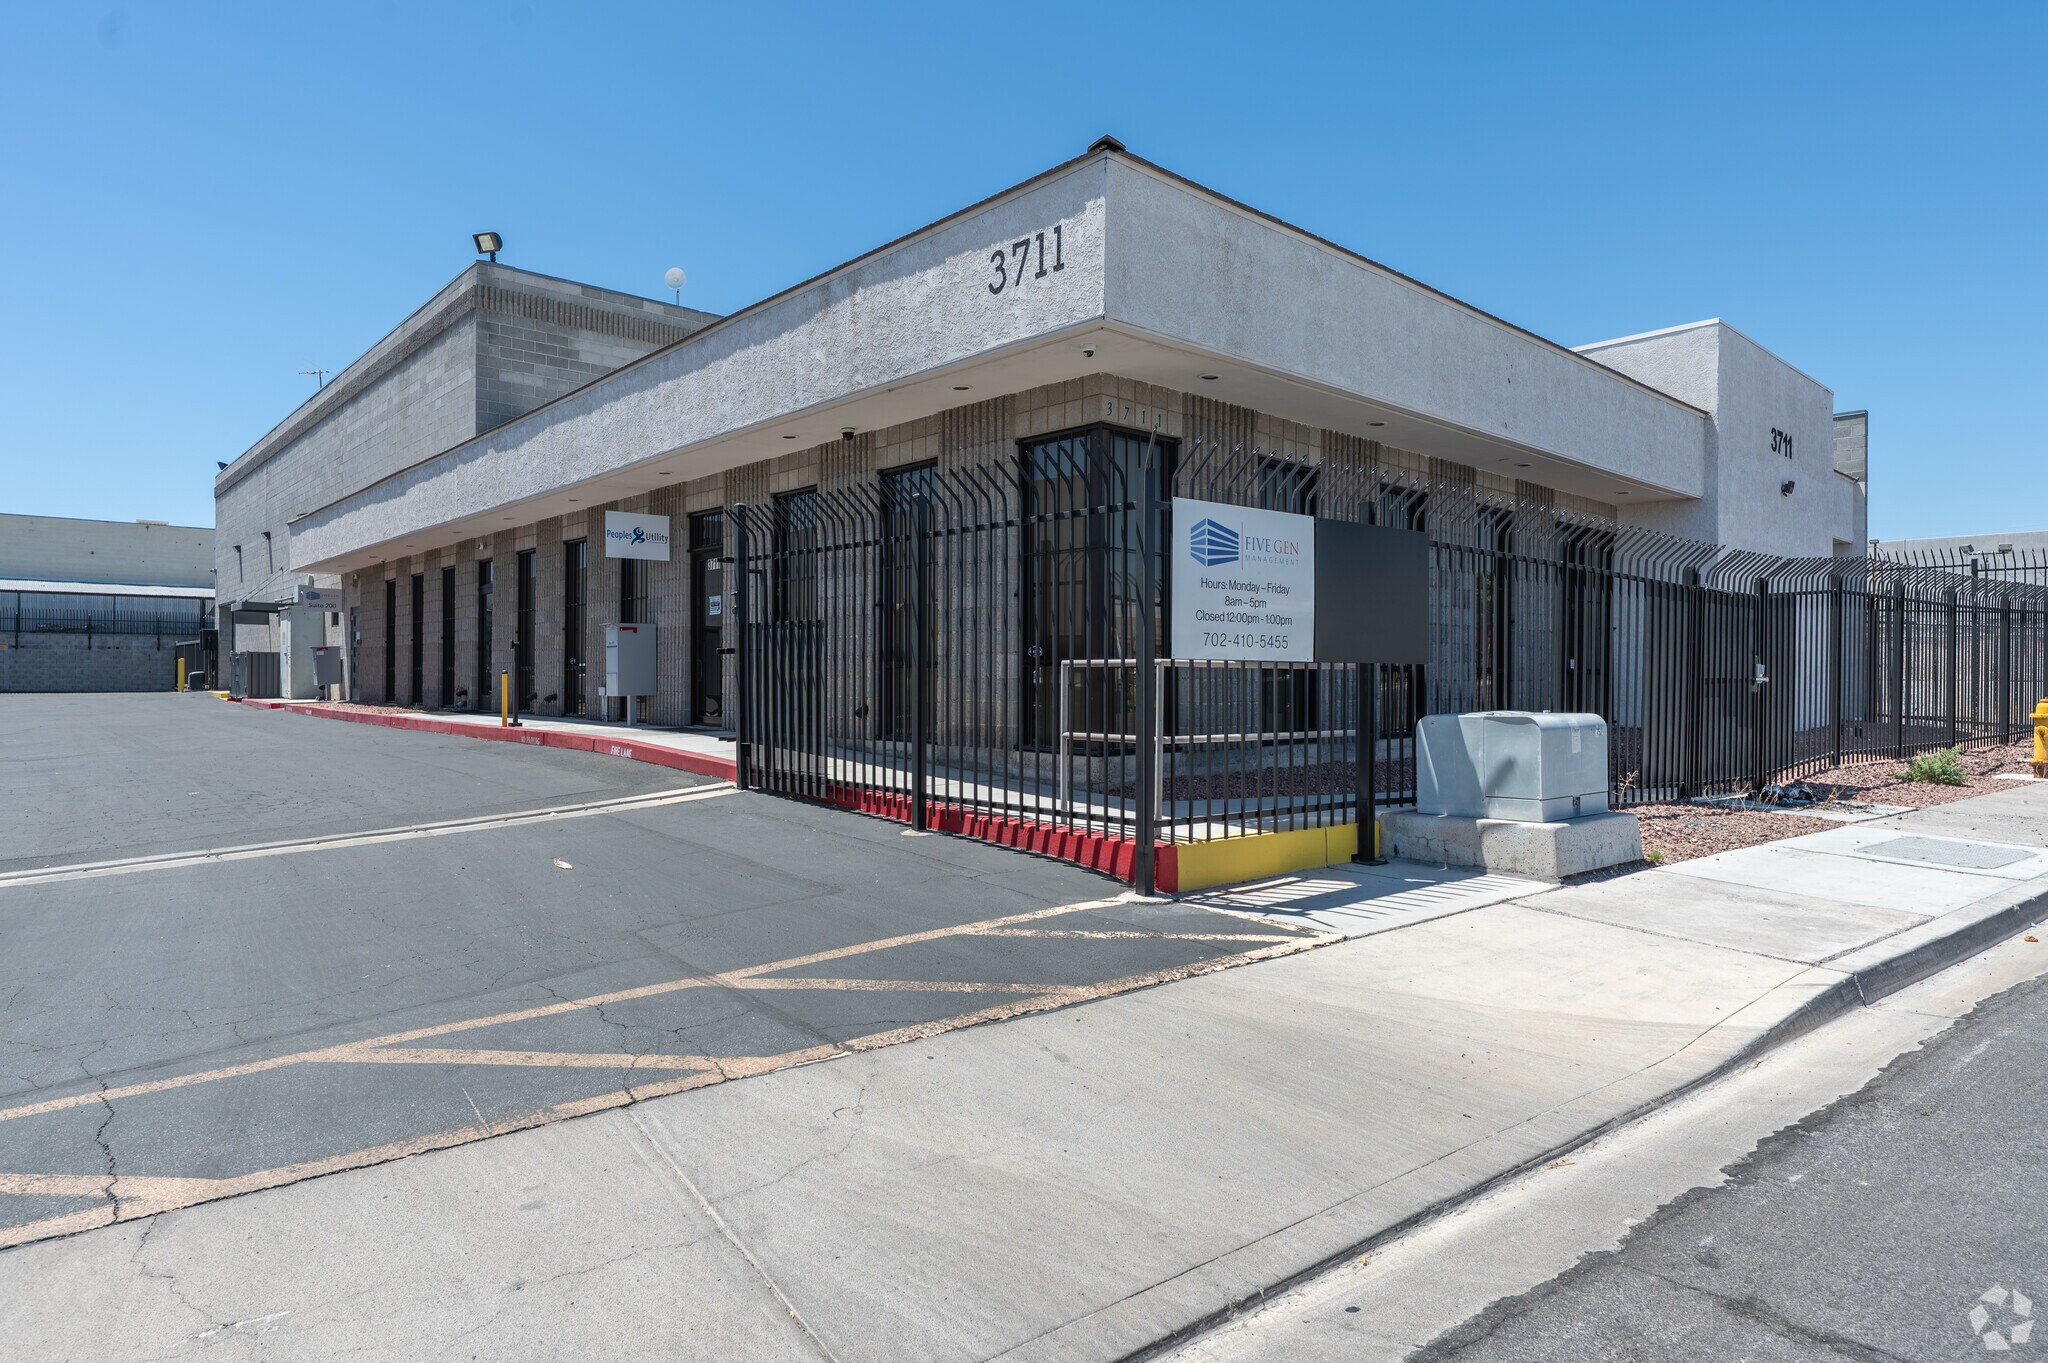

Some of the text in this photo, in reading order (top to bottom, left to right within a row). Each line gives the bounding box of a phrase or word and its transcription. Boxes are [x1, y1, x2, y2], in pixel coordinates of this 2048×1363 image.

[988, 224, 1065, 296] 3711
[1106, 401, 1161, 428] 3711
[1771, 427, 1793, 460] 3711
[606, 529, 668, 544] Peoples Utility
[1245, 536, 1299, 555] FIVE GEN
[1245, 554, 1299, 566] MANAGEMENT
[1200, 577, 1228, 590] Hours:
[1229, 580, 1260, 594] Monday
[1267, 582, 1290, 596] Friday
[1195, 609, 1225, 622] Closed
[1226, 612, 1260, 625] 12:00pm
[1265, 614, 1293, 626] 1:00pm
[1203, 632, 1289, 649] 702-410-5455
[610, 745, 632, 759] FIRE LANE
